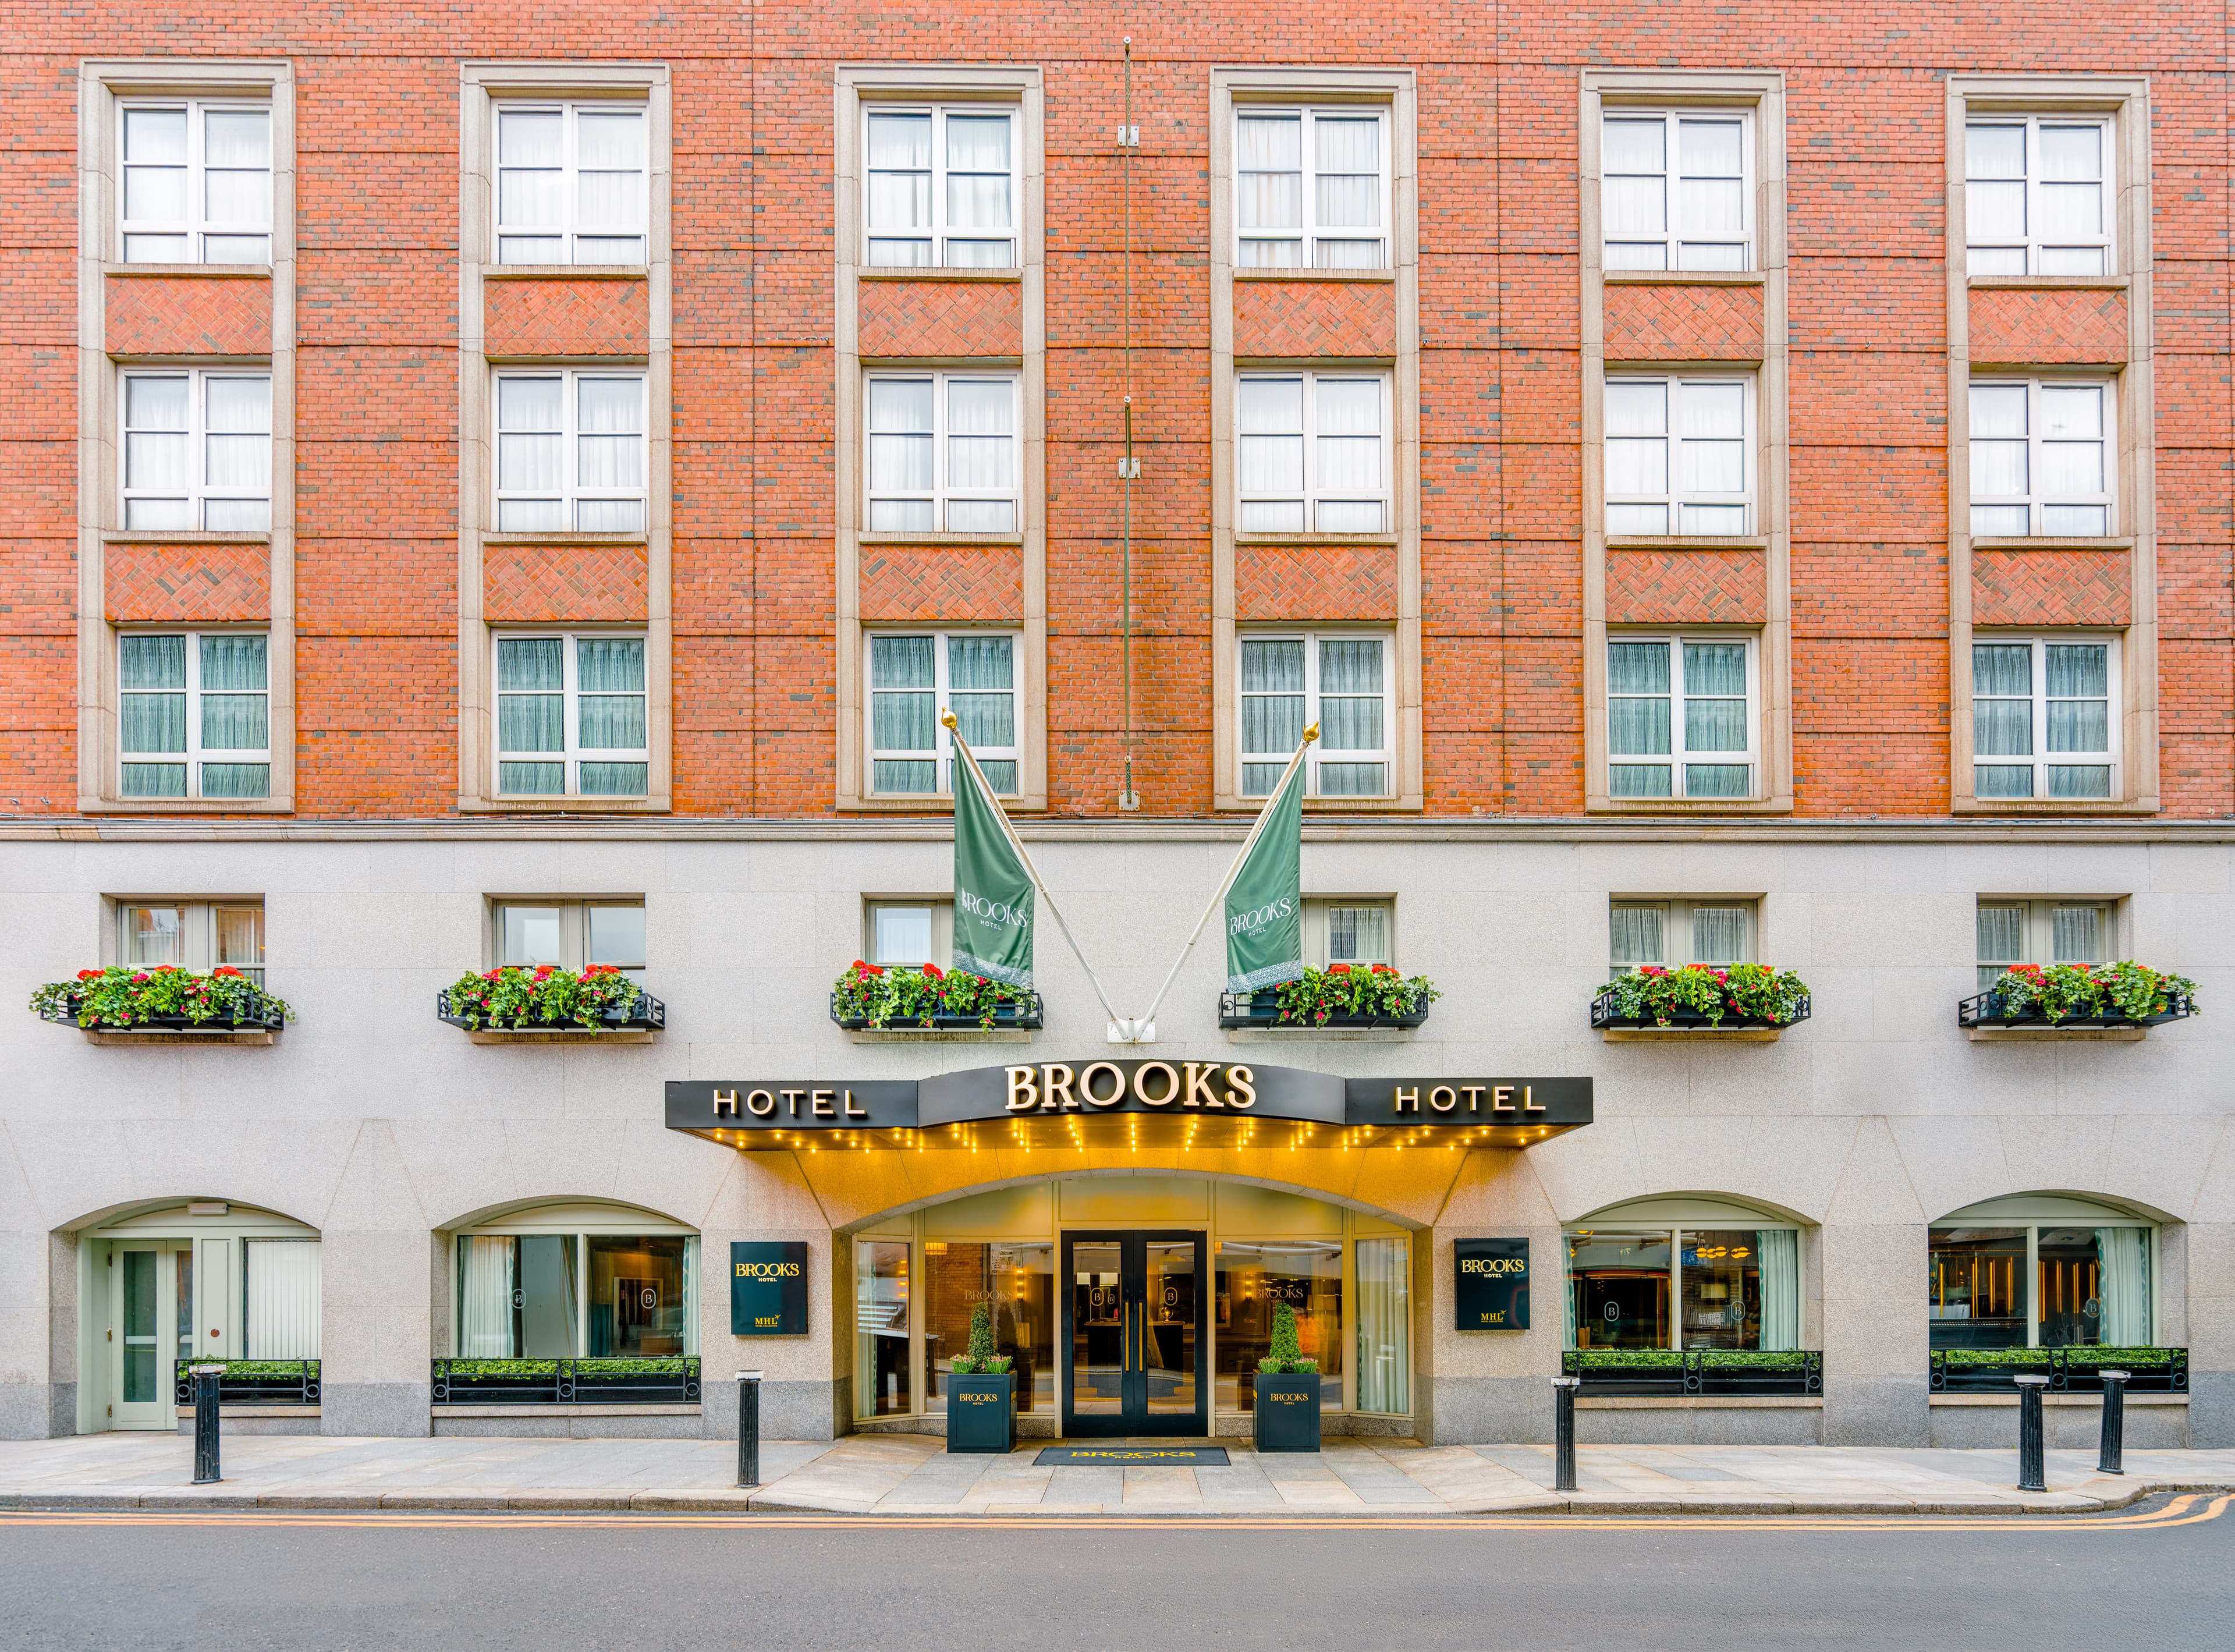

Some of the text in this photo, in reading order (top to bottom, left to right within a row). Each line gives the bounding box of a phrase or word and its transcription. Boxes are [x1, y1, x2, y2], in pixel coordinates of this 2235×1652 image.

[962, 887, 1027, 927] BROOKS
[1230, 898, 1292, 935] BROOKS
[980, 920, 1002, 930] HOTEL
[1248, 927, 1266, 937] HOTEL
[1005, 1061, 1256, 1109] BROOKS
[713, 1089, 867, 1115] HOTEL
[1395, 1086, 1546, 1111] HOTEL
[735, 1263, 800, 1277] BROOKS
[1461, 1259, 1525, 1273] BROOKS
[1255, 1288, 1303, 1298] BROOKS
[959, 1393, 998, 1402] BROOKS
[1271, 1393, 1308, 1402] BROOKS
